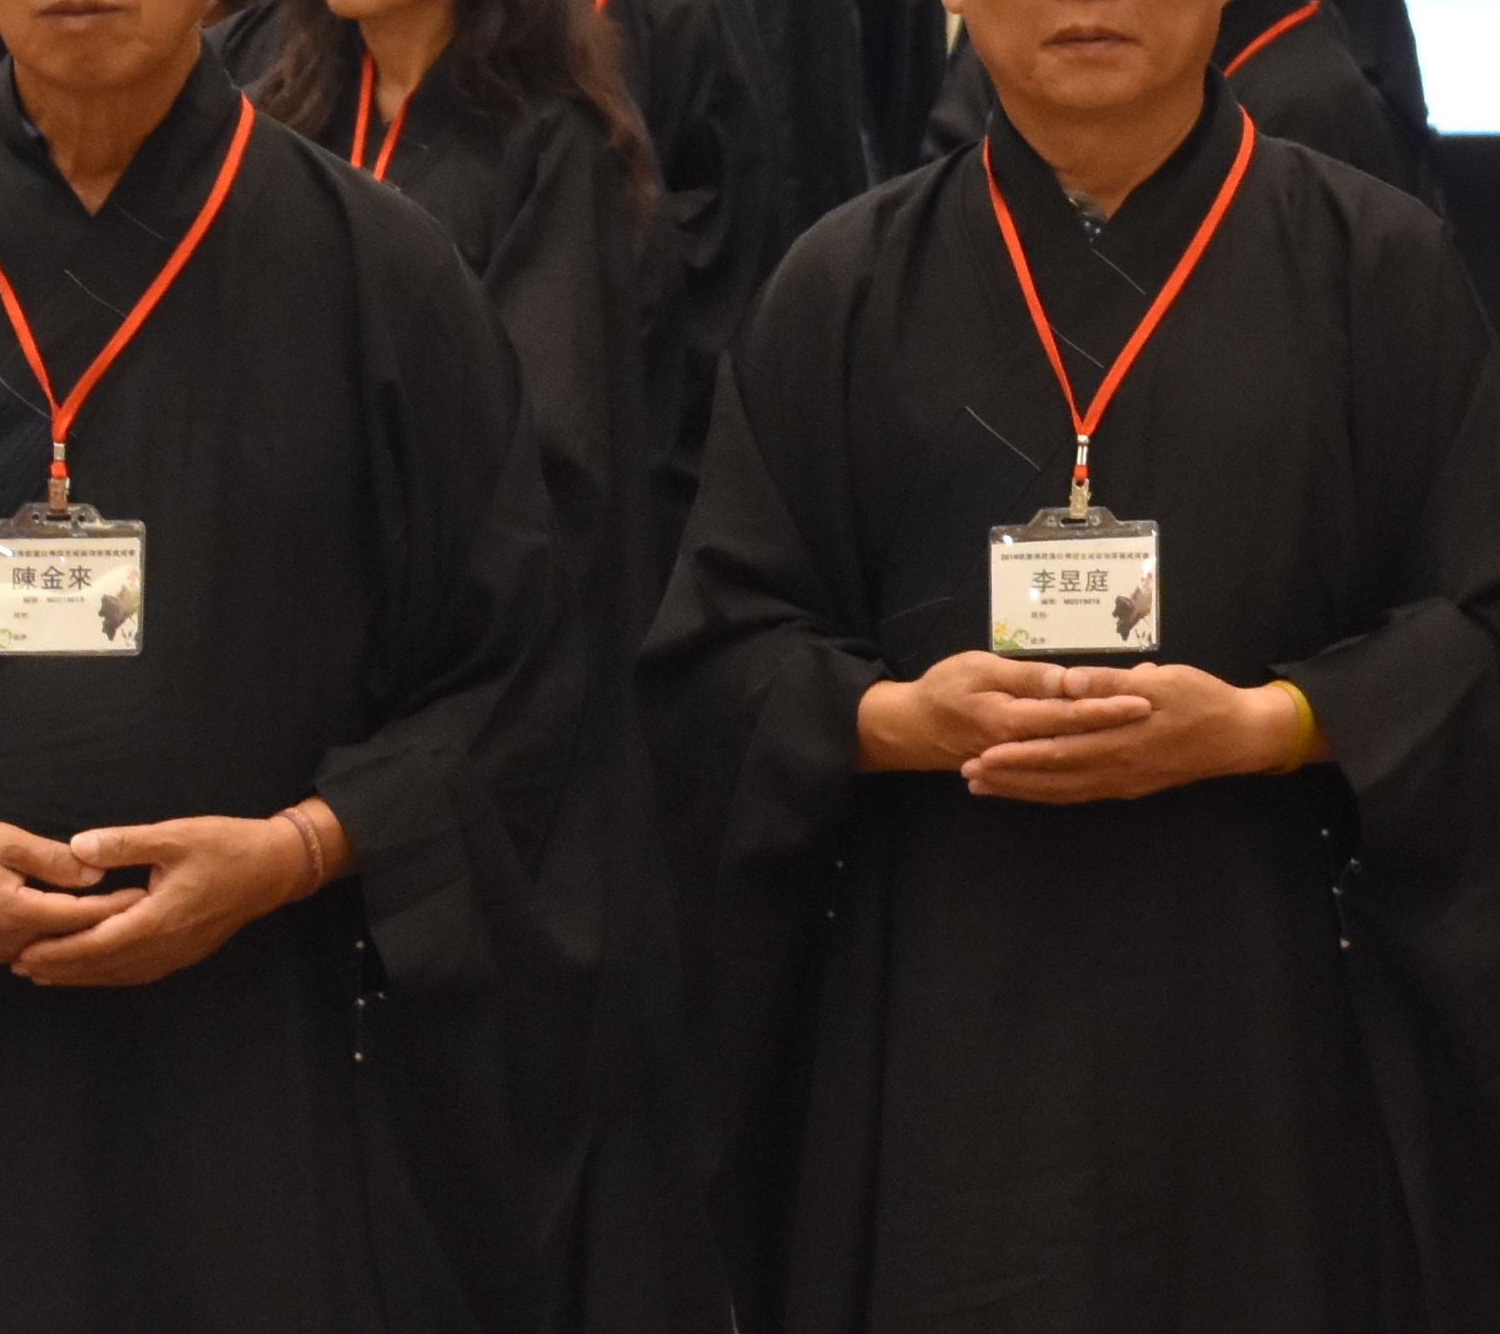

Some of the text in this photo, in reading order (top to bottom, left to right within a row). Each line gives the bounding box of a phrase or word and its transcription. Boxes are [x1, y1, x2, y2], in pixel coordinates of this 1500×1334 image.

[12, 565, 92, 591] 陳金來
[1032, 569, 1109, 593] 李昱庭
